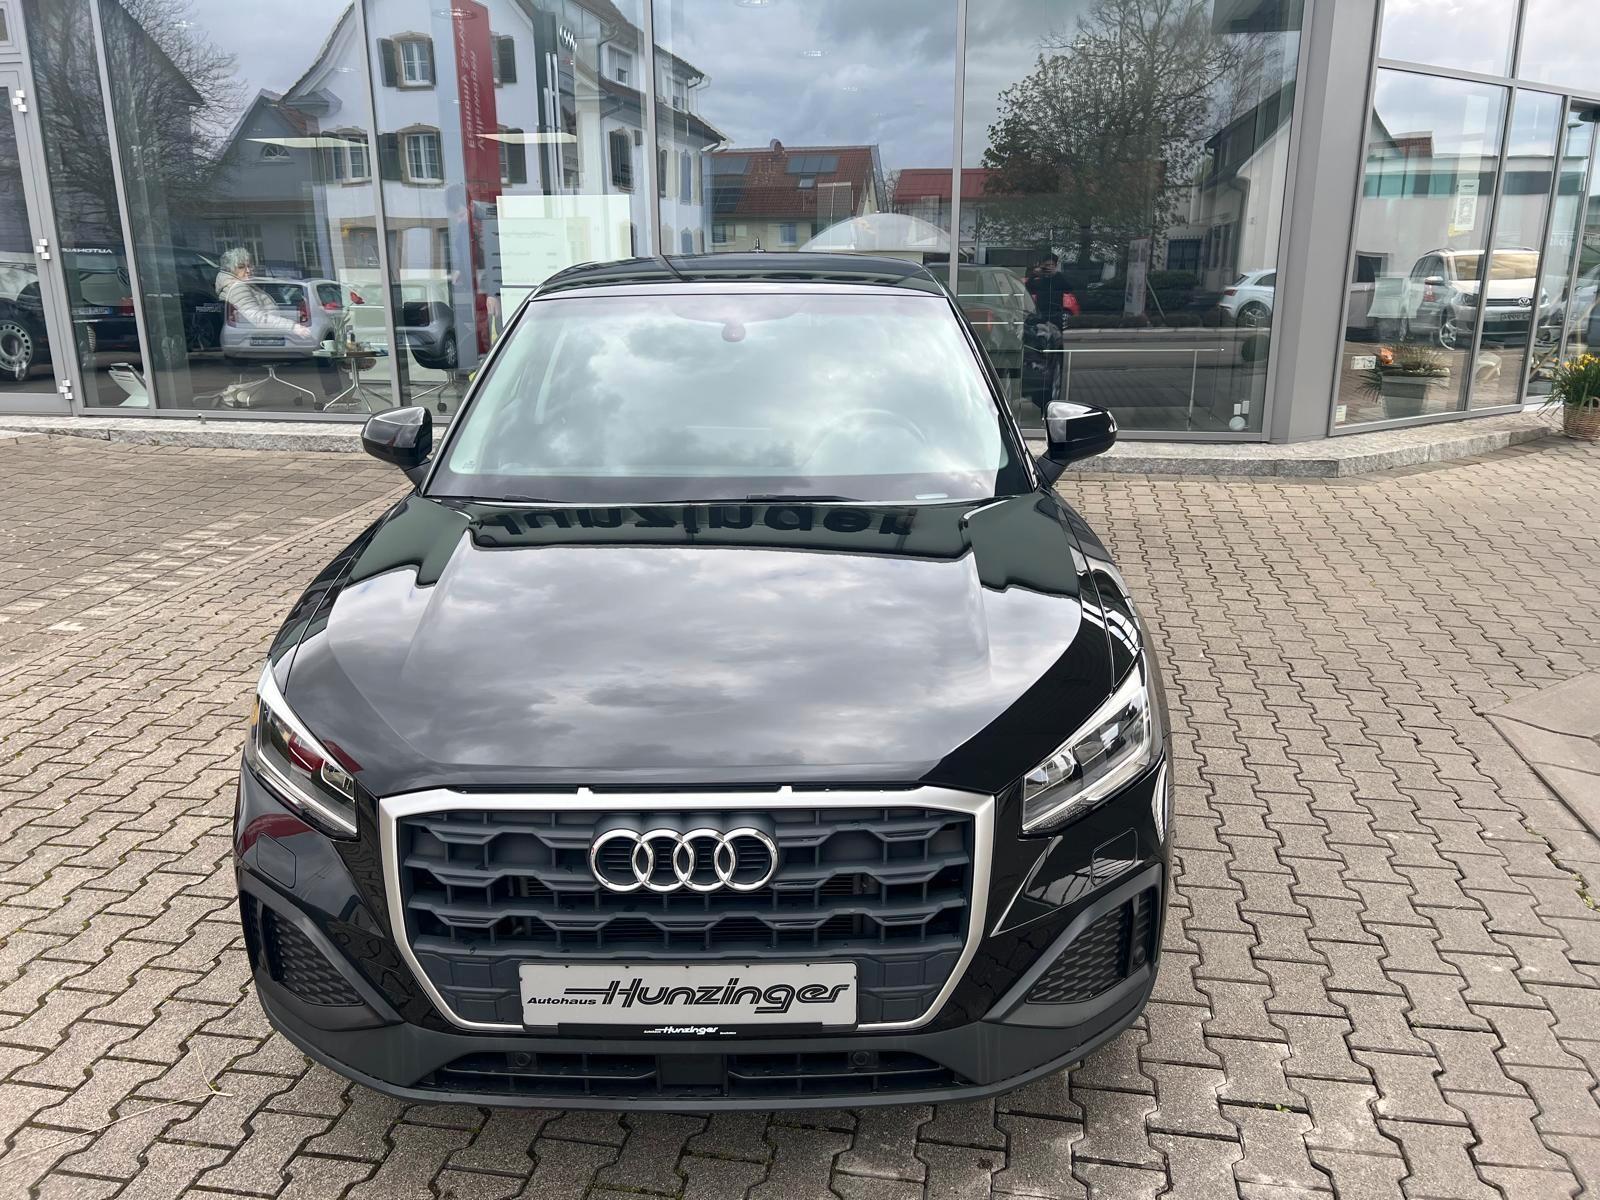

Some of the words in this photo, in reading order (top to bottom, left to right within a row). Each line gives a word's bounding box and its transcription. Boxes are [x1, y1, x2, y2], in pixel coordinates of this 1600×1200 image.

[527, 997, 597, 1005] Autohaus
[564, 978, 850, 1014] Hunzinger
[655, 1026, 718, 1035] Hunzinger
